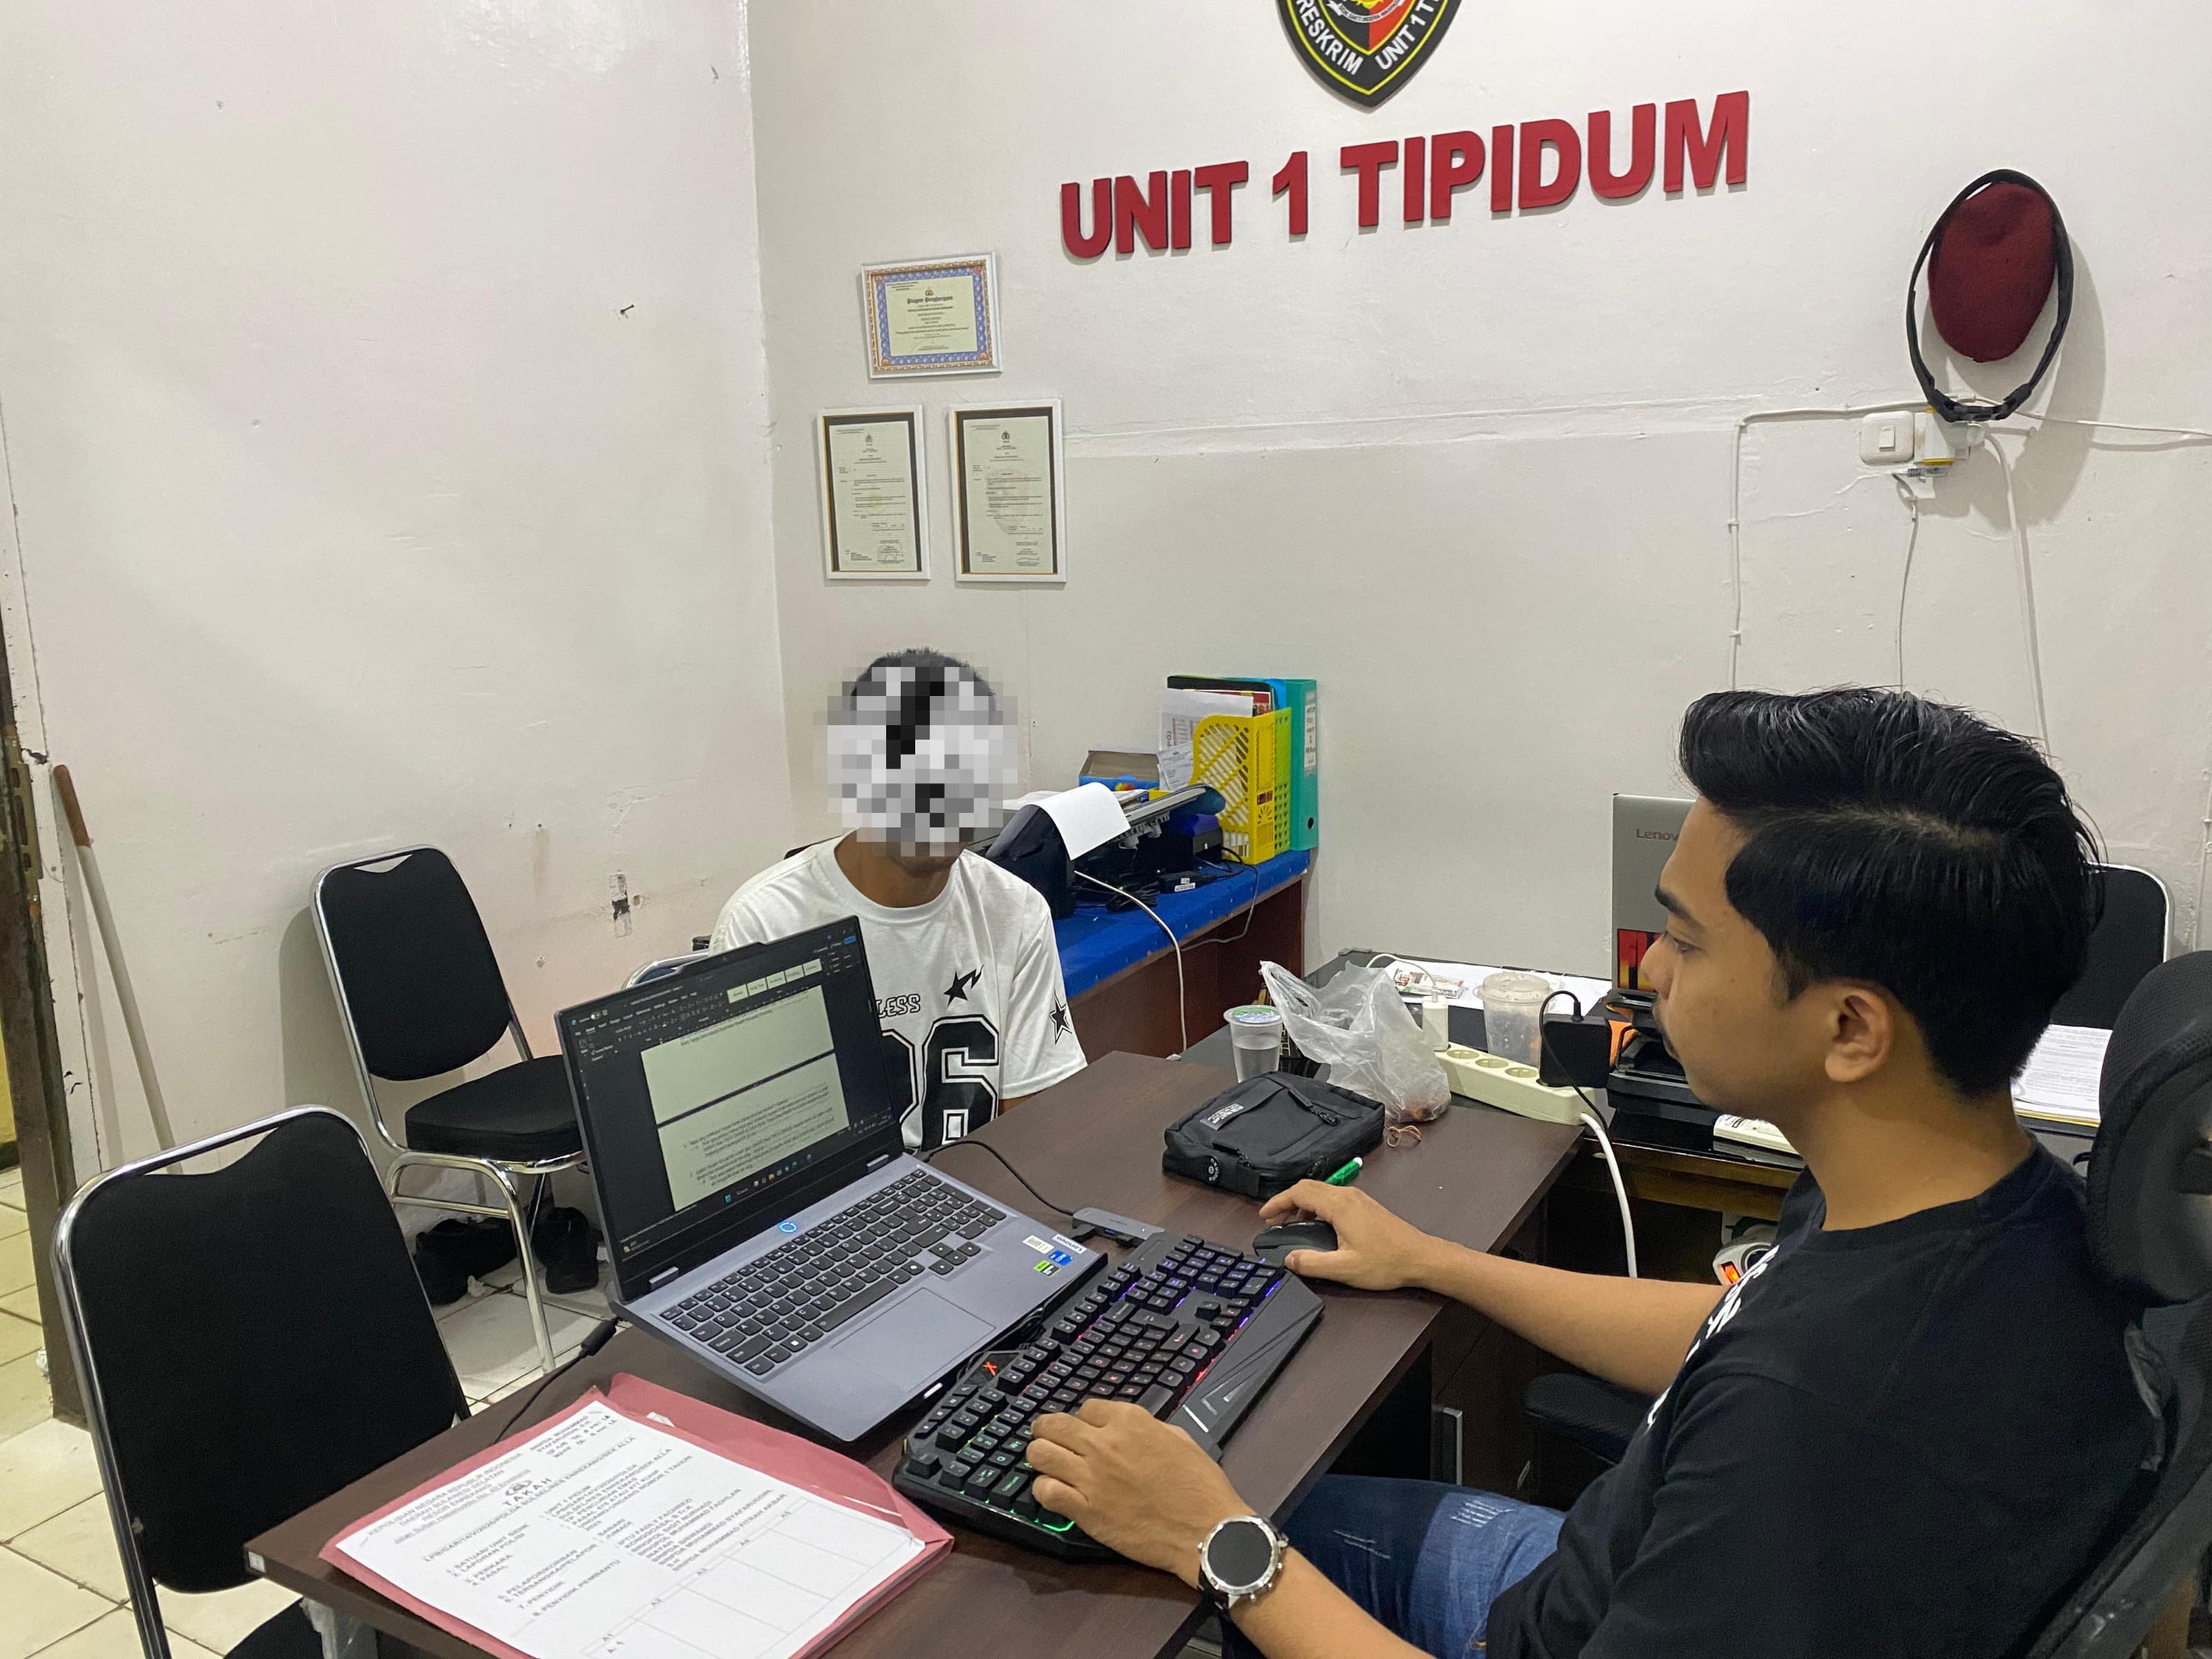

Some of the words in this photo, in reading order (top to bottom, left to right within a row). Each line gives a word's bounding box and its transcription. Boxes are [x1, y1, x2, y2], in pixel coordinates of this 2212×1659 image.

[1375, 25, 1415, 69] UNIT
[1411, 14, 1426, 26] 1
[1060, 160, 1248, 258] UNIT
[1271, 150, 1308, 234] 1
[1340, 90, 1748, 227] TIPIDUM
[1635, 828, 1679, 841] Lenov
[1056, 1235, 1084, 1251] Lenovo
[502, 1478, 552, 1506] TAKAH
